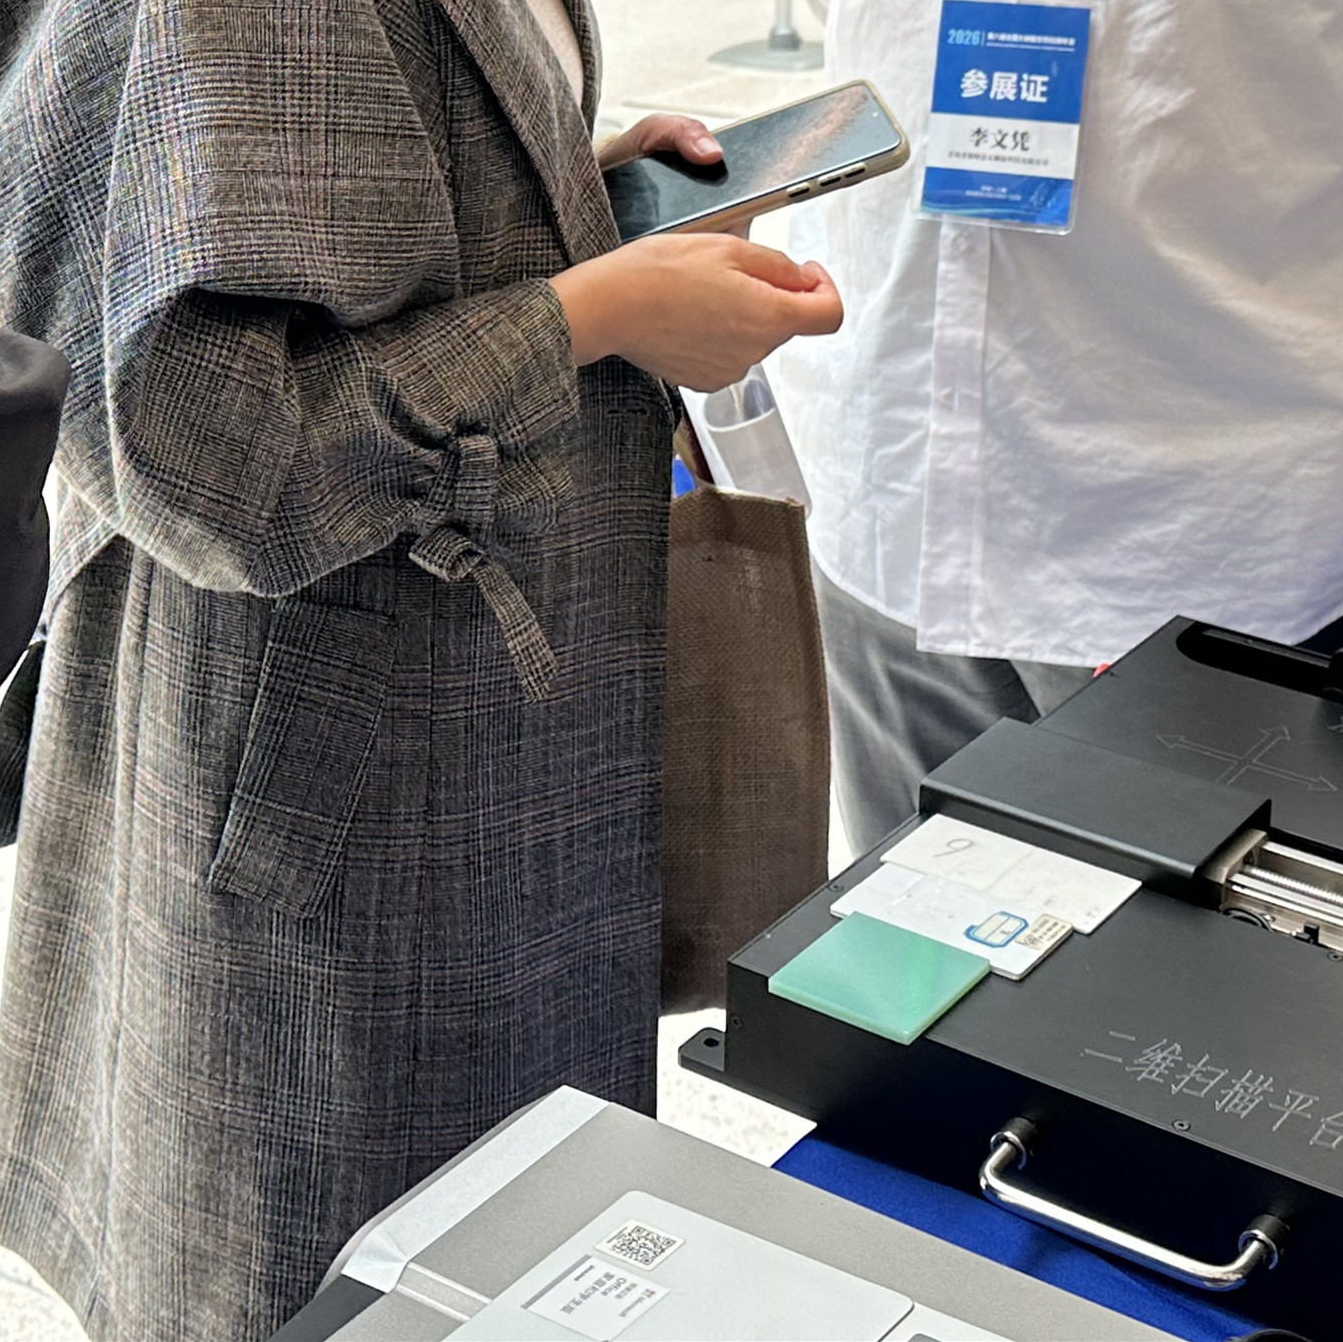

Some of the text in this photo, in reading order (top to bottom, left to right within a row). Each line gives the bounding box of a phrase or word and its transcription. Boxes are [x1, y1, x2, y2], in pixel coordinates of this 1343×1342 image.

[947, 29, 981, 46] 2026
[961, 69, 1050, 104] 参展证
[601, 1276, 627, 1297] Office
